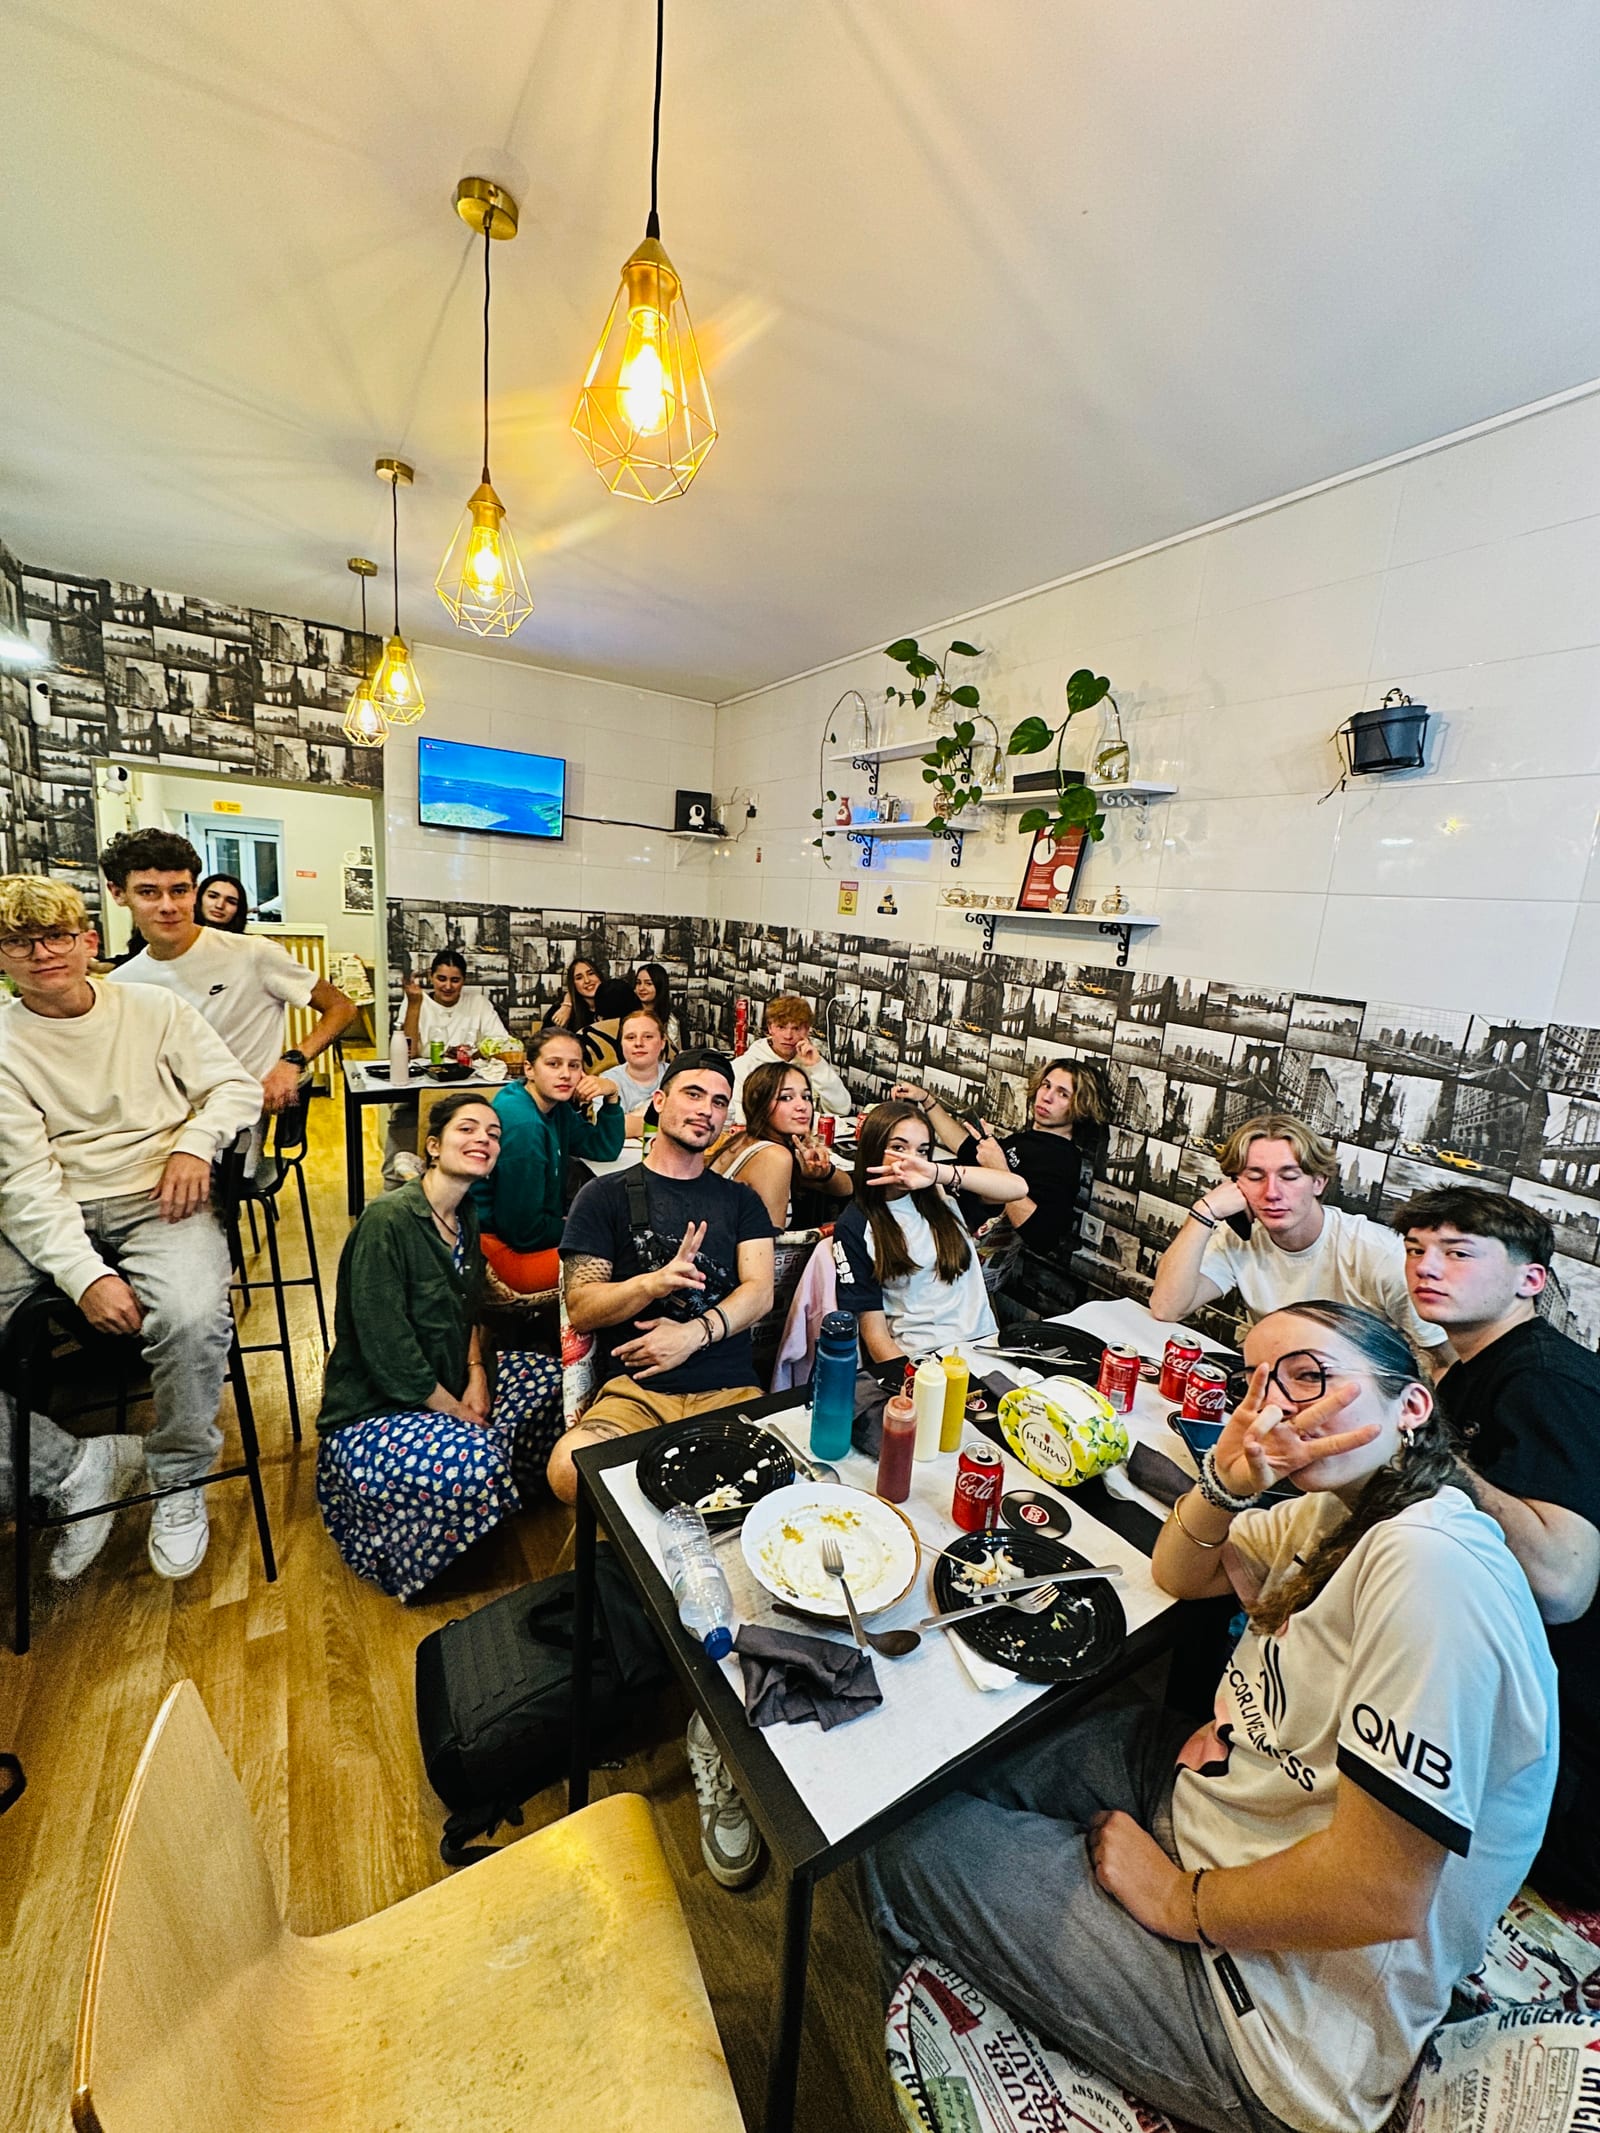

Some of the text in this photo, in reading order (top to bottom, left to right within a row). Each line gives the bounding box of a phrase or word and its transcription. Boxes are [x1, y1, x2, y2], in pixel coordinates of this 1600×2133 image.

[1026, 1431, 1068, 1467] PEDRAS
[1351, 1703, 1453, 1790] QNB
[1497, 2006, 1585, 2031] HYGIENIC
[1072, 2083, 1133, 2132] ANSWERED
